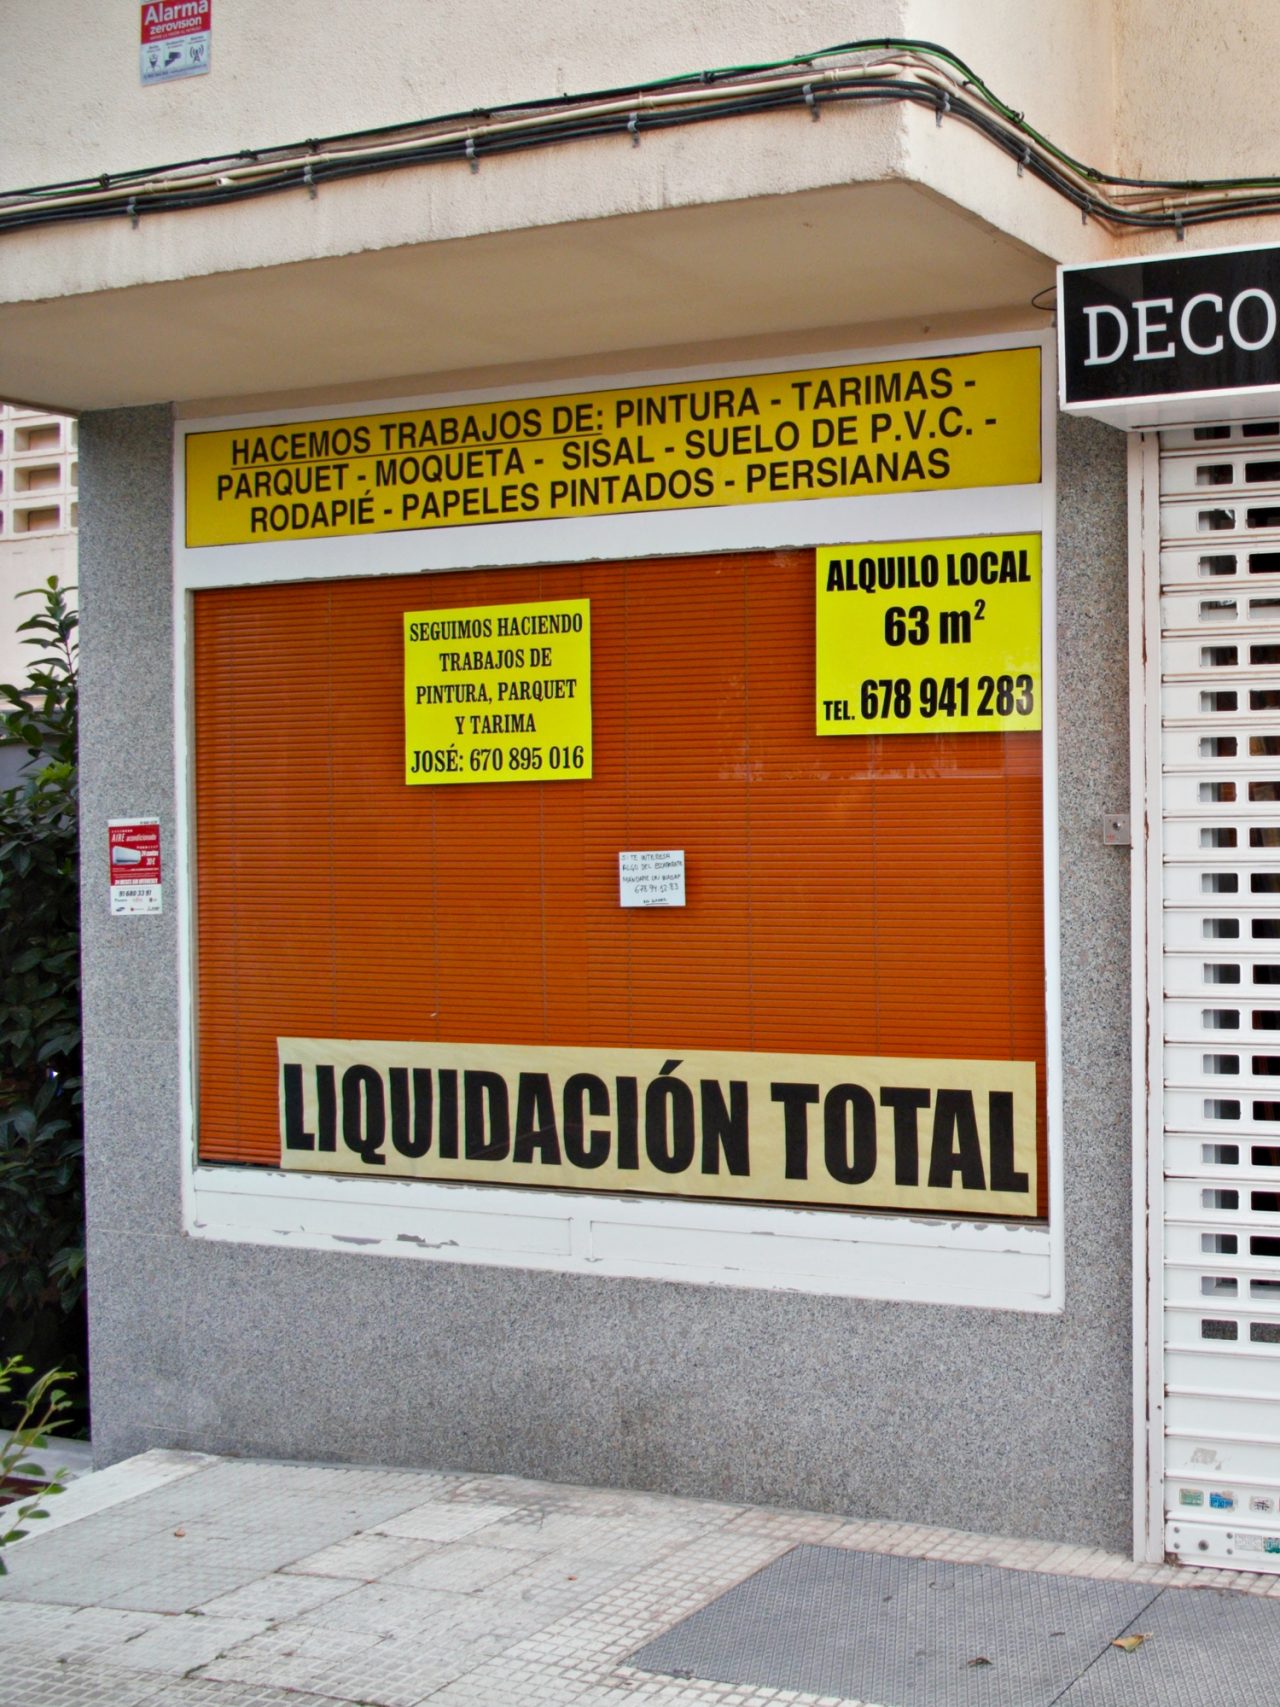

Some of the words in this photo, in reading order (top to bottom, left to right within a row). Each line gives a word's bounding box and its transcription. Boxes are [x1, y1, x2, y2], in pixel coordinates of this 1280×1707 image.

[144, 0, 208, 26] Alarma
[150, 16, 202, 35] zerovision
[231, 427, 371, 466] HACEMOS
[380, 408, 542, 451] TRABAJOS
[552, 403, 603, 435] DE:
[615, 387, 759, 428] PINTURA
[791, 368, 953, 411] TARIMAS
[217, 464, 349, 501] PARQUET
[375, 446, 525, 488] MOQUETA
[562, 437, 654, 471] SISAL
[685, 420, 800, 460] SUELO
[811, 415, 859, 449] DE
[870, 406, 974, 444] P.V.C.
[251, 489, 374, 533] RODAPIÉ
[402, 482, 540, 521] PAPELES
[550, 467, 714, 510] PINTADOS
[746, 448, 950, 493] PERSIANAS
[827, 555, 938, 593] ALQUILO
[947, 550, 1031, 586] LOCAL
[410, 619, 492, 642] SEGUIMOS
[498, 613, 583, 637] HACIENDO
[885, 605, 930, 646] 63
[440, 649, 525, 672] TRABAJOS
[530, 648, 552, 667] DE
[416, 683, 493, 704] PINTURA,
[498, 679, 577, 702] PARQUET
[823, 700, 856, 721] TEL.
[861, 678, 911, 719] 678
[920, 677, 969, 718] 941
[976, 674, 1034, 716] 283
[455, 716, 465, 735] Y
[470, 713, 536, 734] TARIMA
[411, 743, 464, 773] JOSÉ:
[470, 748, 503, 771] 670
[509, 747, 542, 770] 895
[549, 745, 584, 769] 016
[283, 1059, 751, 1177] LIQUIDACIÓN
[771, 1081, 1029, 1193] TOTAL
